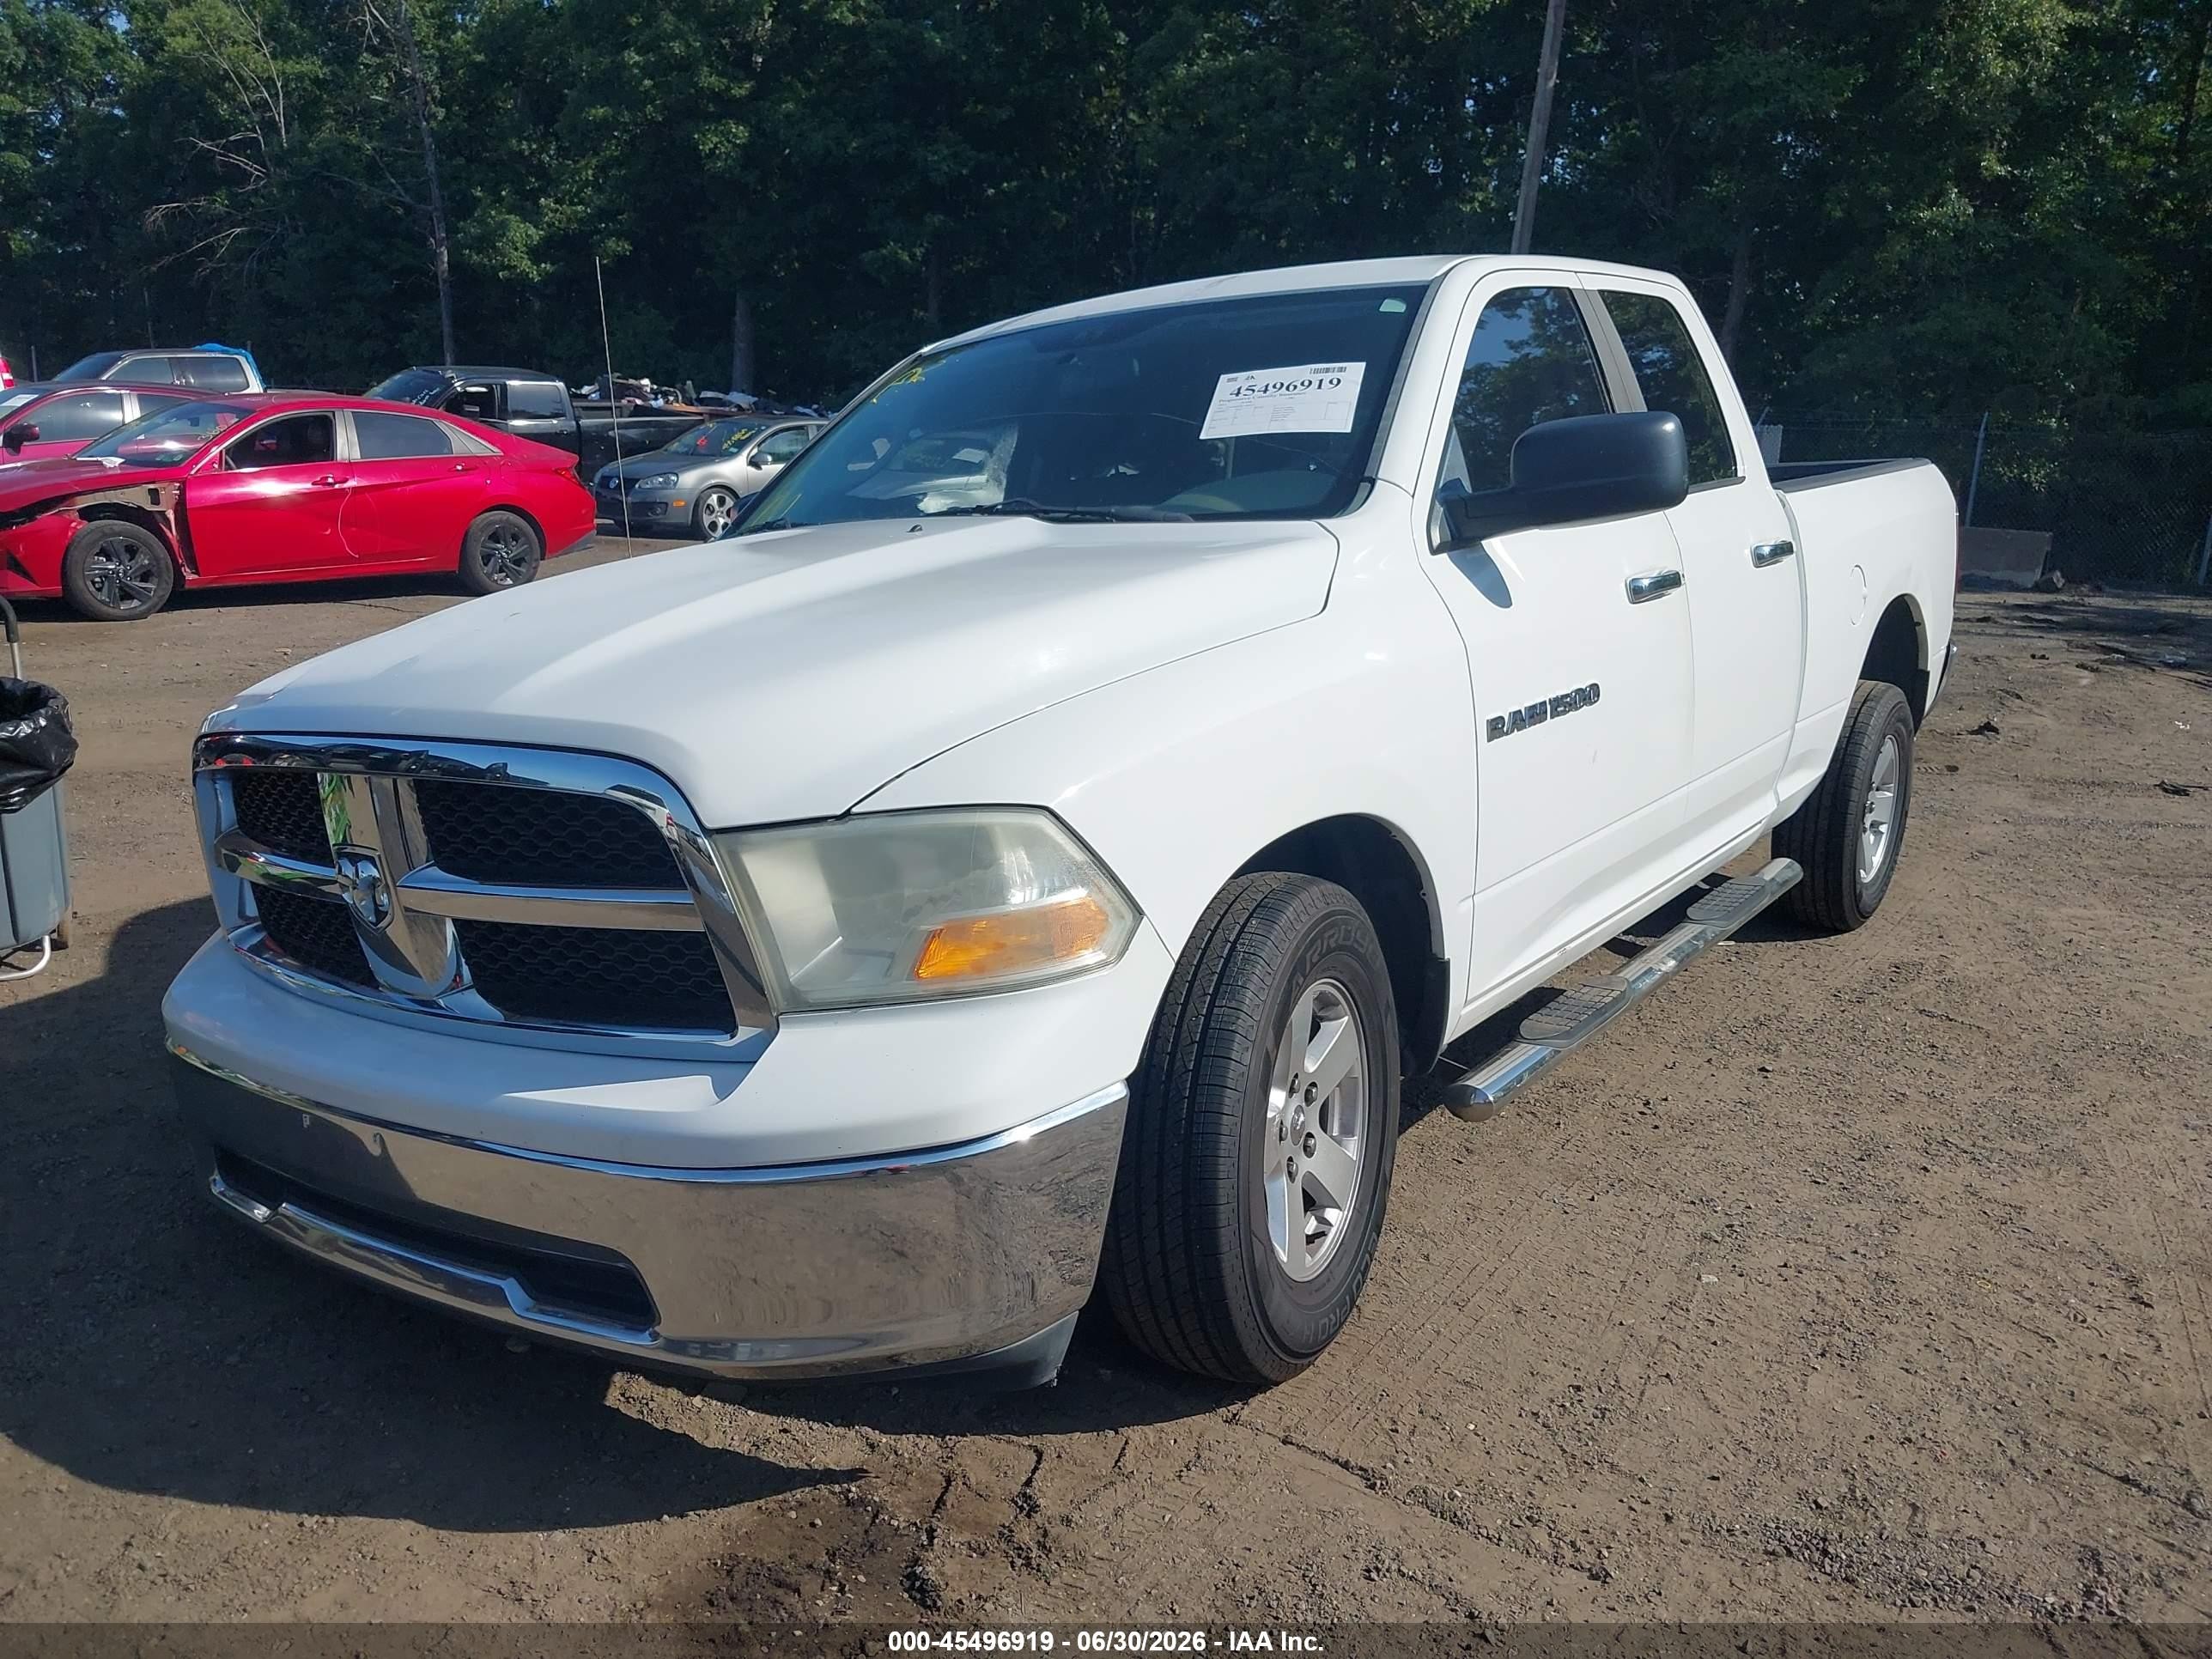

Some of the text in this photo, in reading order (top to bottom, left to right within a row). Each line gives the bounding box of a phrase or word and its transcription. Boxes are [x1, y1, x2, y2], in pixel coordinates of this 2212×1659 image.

[1229, 376, 1342, 398] 45496919
[1486, 683, 1601, 743] RAM 1500
